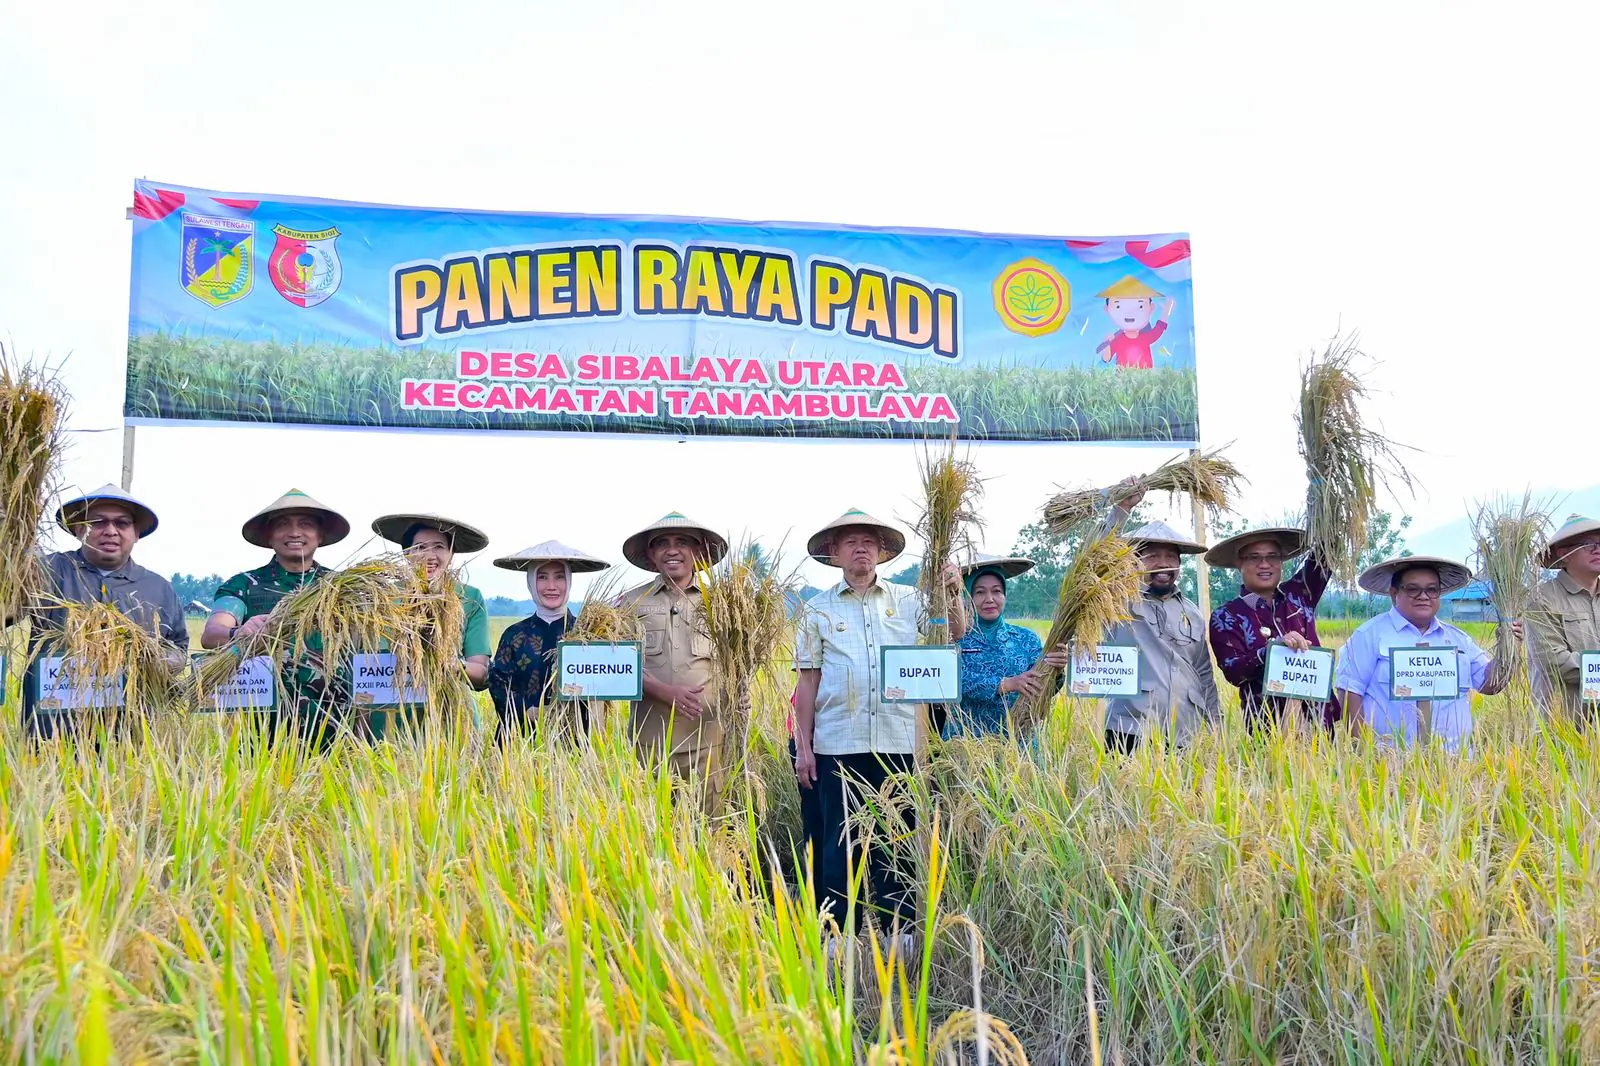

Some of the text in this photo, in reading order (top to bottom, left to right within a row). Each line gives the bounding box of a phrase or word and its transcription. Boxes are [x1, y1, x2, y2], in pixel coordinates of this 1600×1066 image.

[185, 214, 250, 230] SULAWESI TENGAH
[277, 226, 337, 240] KABUPATEN SIGI
[396, 246, 956, 357] PANEN RAYA PADI
[460, 351, 904, 387] DESA SIBALAYA UTARA
[404, 381, 956, 420] KECAMATAN TANAMBULAVA
[1284, 656, 1318, 670] WAKIL
[1408, 656, 1443, 667] KETUA
[566, 663, 633, 675] GUBERNUR
[899, 667, 941, 678] BUPATI
[1075, 666, 1134, 676] DPRD PROVINSI
[1396, 670, 1456, 678] DPRD KABUPATEN
[1088, 677, 1122, 686] SULTENG
[1282, 670, 1318, 685] BUPATI
